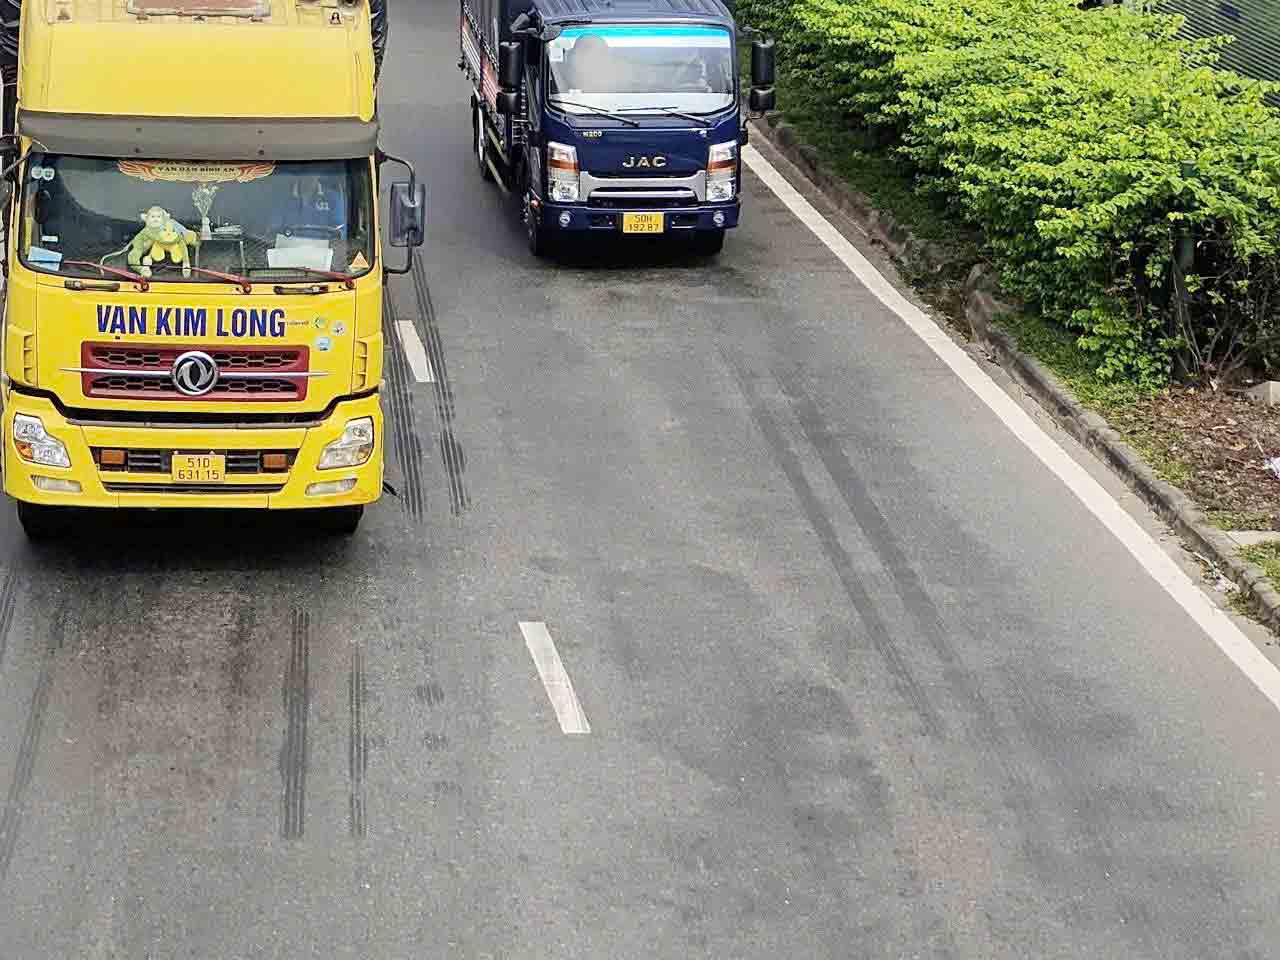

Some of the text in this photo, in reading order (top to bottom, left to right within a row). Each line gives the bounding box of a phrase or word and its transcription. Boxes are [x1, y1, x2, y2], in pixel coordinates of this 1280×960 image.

[622, 156, 666, 167] JAC
[96, 304, 286, 340] VẠN KIM LONG
